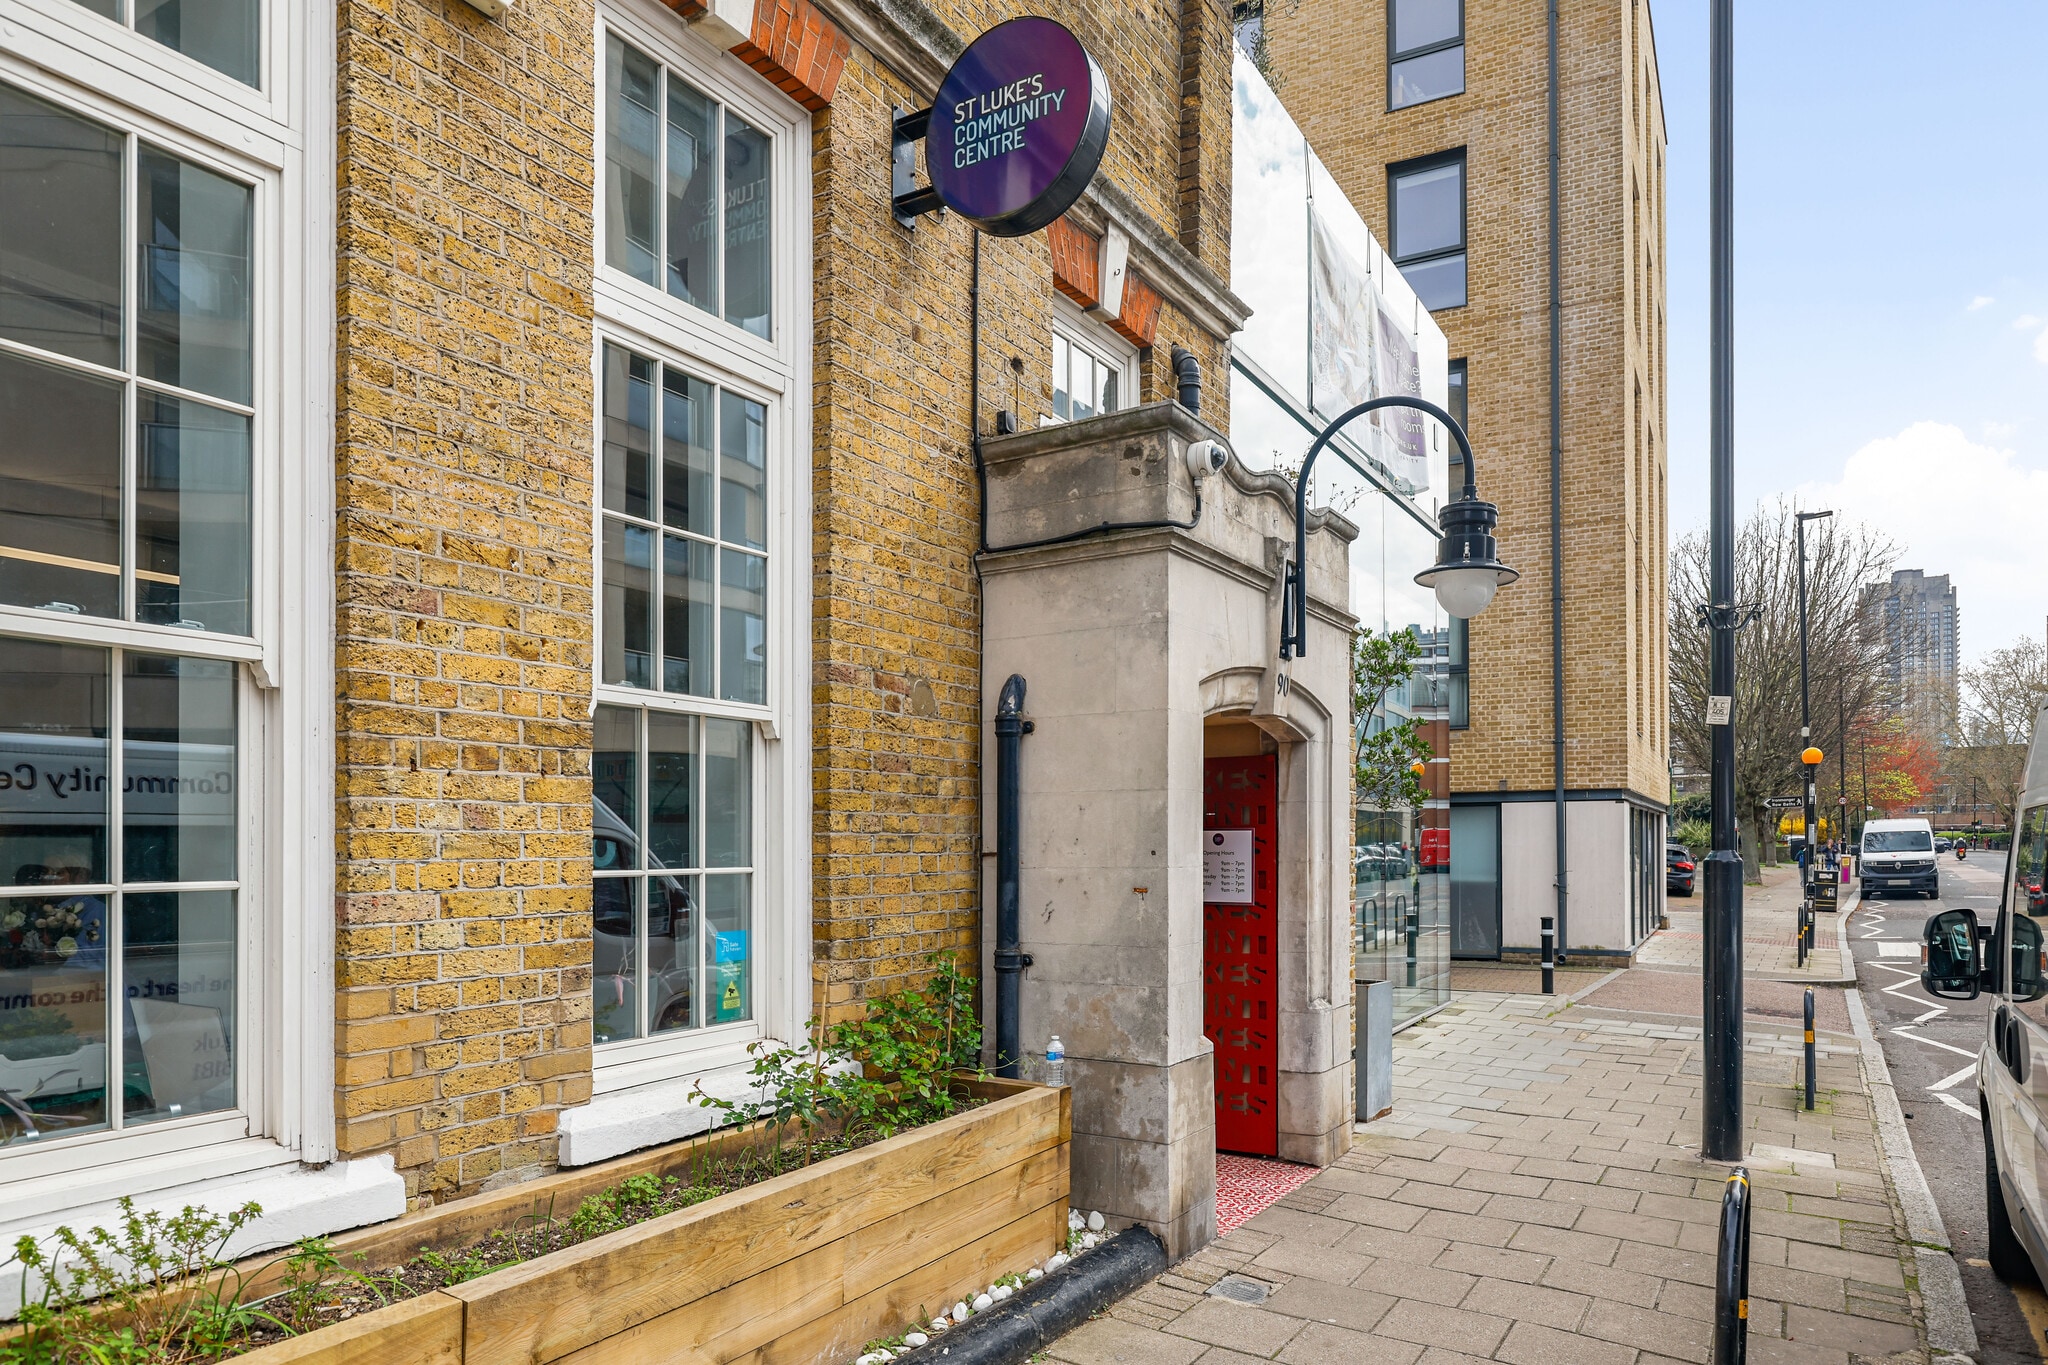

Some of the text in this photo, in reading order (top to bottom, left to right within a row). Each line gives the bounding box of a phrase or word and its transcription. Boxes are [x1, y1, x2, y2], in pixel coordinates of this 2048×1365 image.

[954, 73, 1043, 124] ST LUKE'S
[954, 88, 1066, 146] COMMUNITY
[954, 126, 1026, 169] CENTRE
[1277, 672, 1290, 698] 90
